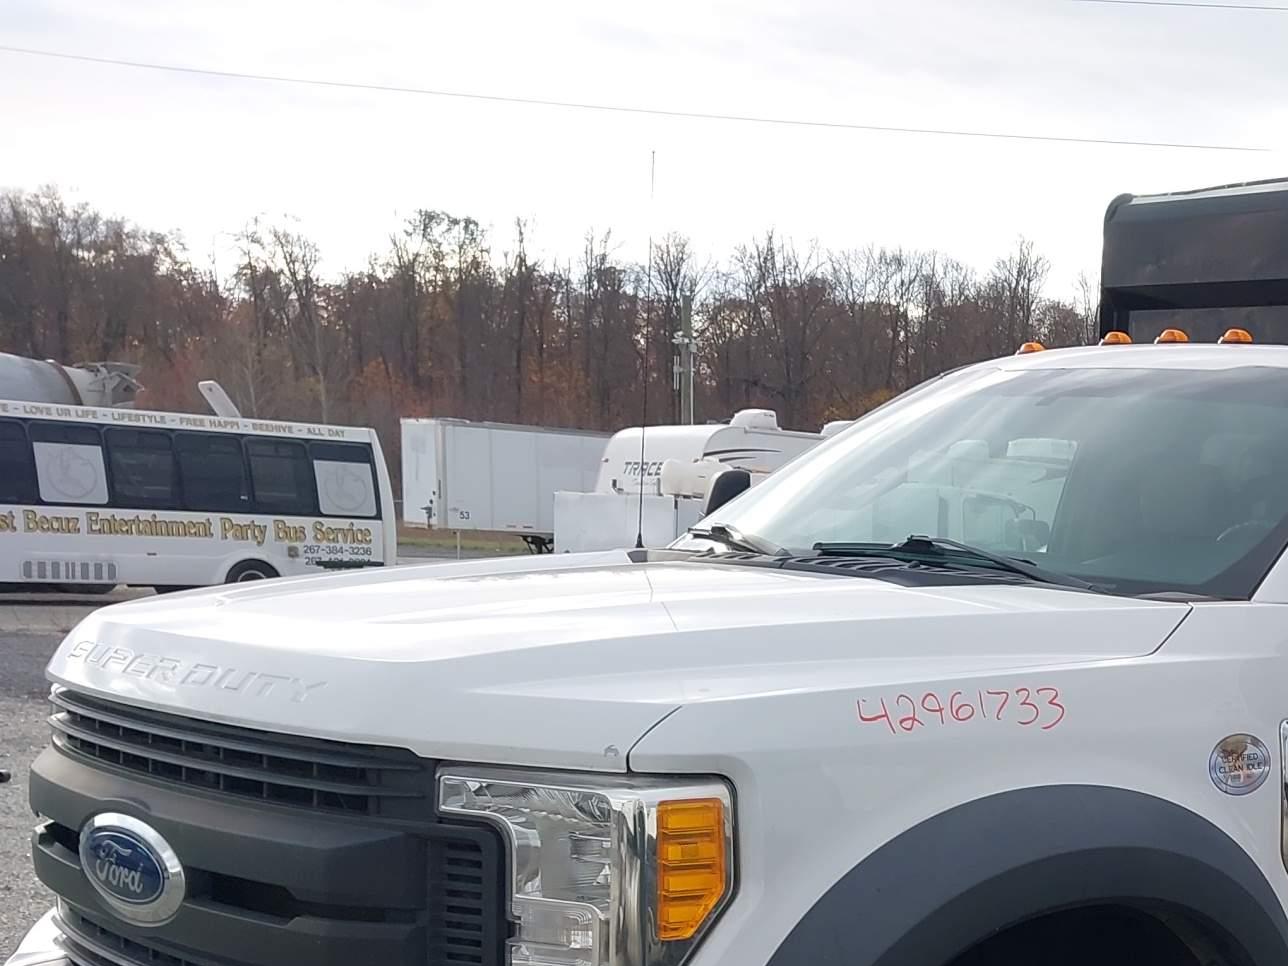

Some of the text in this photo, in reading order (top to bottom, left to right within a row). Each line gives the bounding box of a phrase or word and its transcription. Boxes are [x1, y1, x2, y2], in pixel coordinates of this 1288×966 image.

[23, 404, 51, 416] LOVE
[57, 407, 71, 417] UR
[75, 409, 98, 419] LIFE
[111, 412, 166, 424] LIFESTYLE
[179, 416, 206, 428] FREE
[208, 419, 240, 430] HAPPI
[306, 427, 324, 436] ALL
[328, 428, 345, 438] DAY
[22, 509, 81, 534] Becuz
[86, 511, 214, 538] Entertainment
[220, 517, 267, 547] Party
[273, 519, 307, 543] Bus
[312, 520, 372, 545] Service
[459, 511, 470, 520] 53
[303, 544, 372, 556] 267-384-3236
[66, 640, 328, 703] SUPER DUTY
[857, 687, 1065, 735] 42961733
[1219, 765, 1244, 774] CLEAN
[95, 840, 144, 894] Ford
